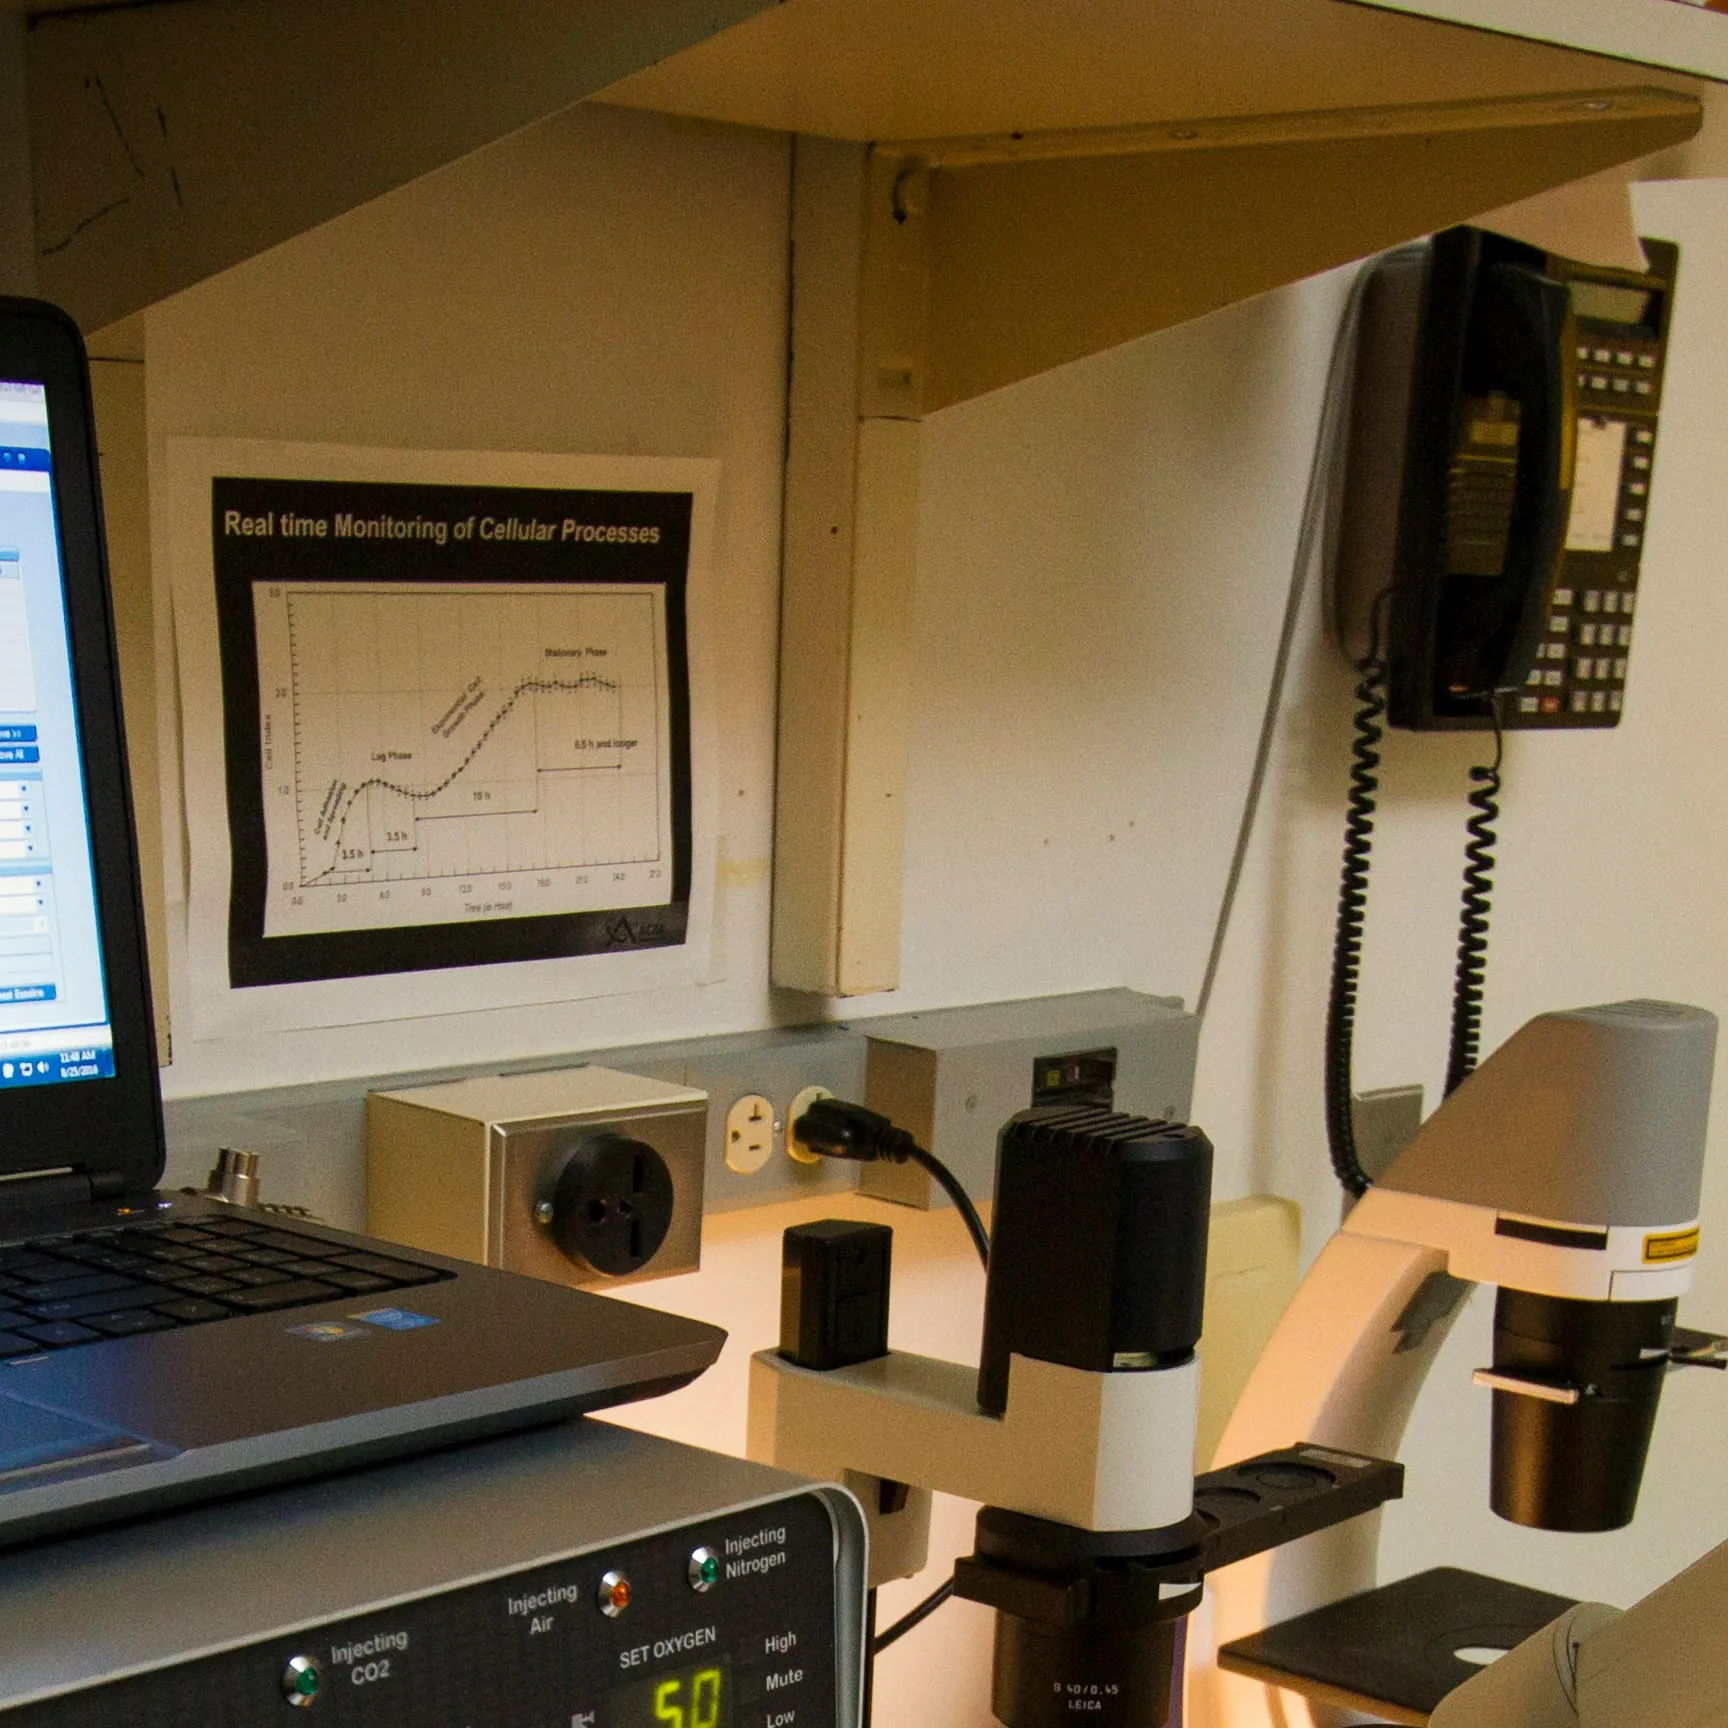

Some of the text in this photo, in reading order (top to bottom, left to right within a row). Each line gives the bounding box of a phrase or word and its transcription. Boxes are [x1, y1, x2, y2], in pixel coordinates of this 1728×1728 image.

[224, 510, 661, 546] Real time Monitoring of Cellular Processes
[371, 750, 413, 763] Lag Phase
[723, 1525, 787, 1556] Injecting
[724, 1549, 786, 1582] Nitrogen
[507, 1581, 578, 1616] Injecting
[529, 1613, 554, 1637] Air
[330, 1629, 408, 1666] Injecting
[618, 1626, 718, 1671] SET OXYGEN
[764, 1630, 798, 1656] High
[350, 1658, 391, 1686] CO2
[765, 1666, 804, 1693] Mute
[1067, 1683, 1119, 1696] 40/0.45
[1068, 1699, 1102, 1711] LEICA
